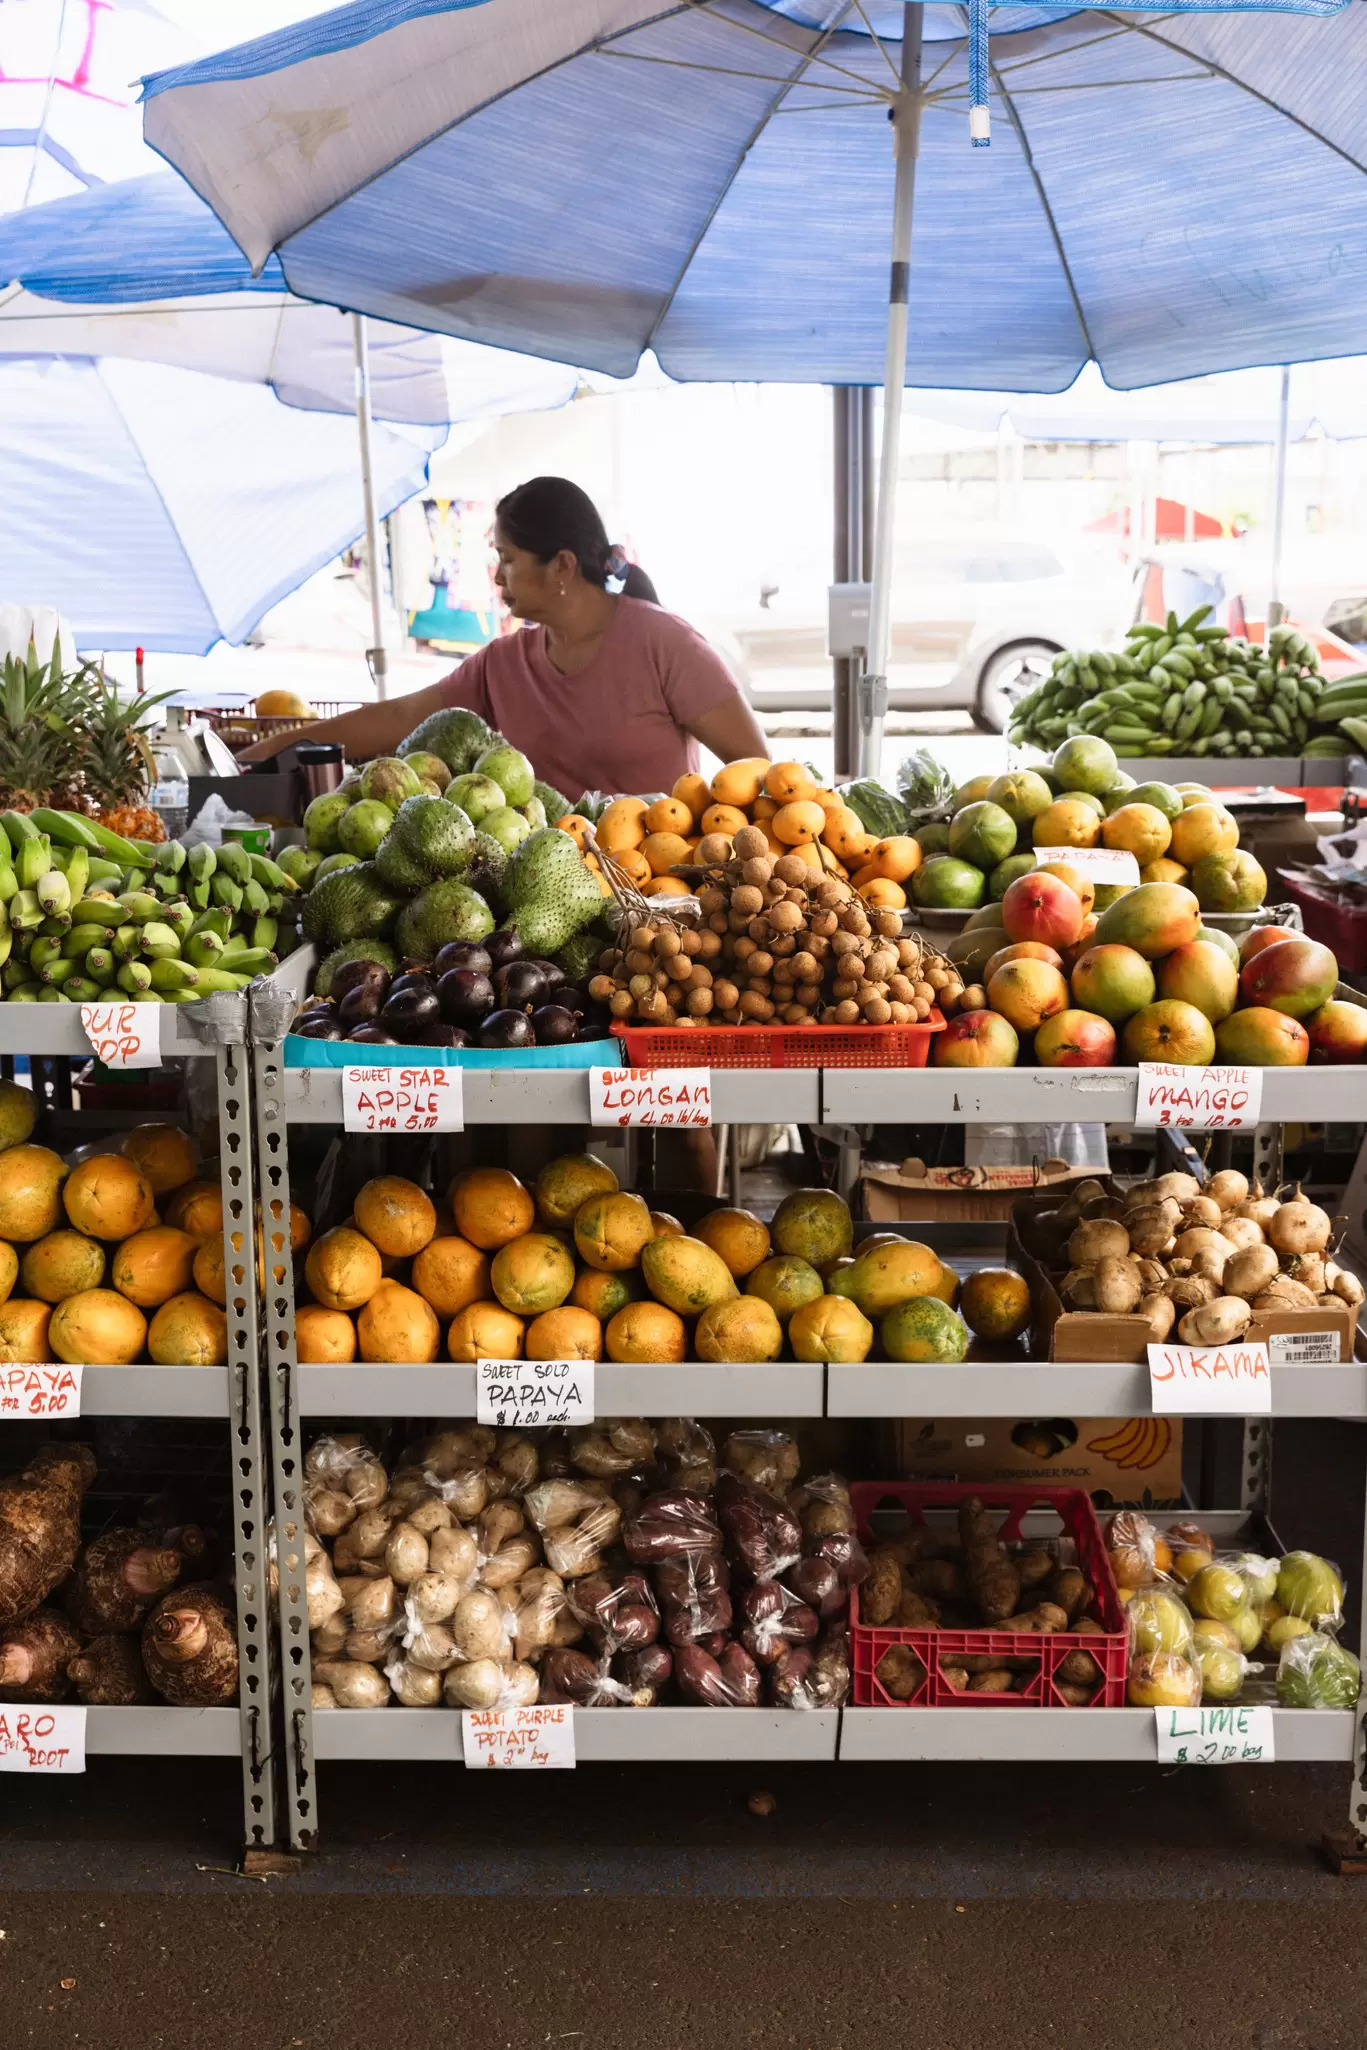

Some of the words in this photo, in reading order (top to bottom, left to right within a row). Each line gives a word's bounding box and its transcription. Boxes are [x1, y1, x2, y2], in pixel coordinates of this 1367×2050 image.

[91, 1036, 140, 1065] OP
[349, 1068, 392, 1083] SWEET
[399, 1068, 450, 1088] STAR
[1144, 1063, 1186, 1078] SWEET
[1201, 1067, 1252, 1084] APPLE
[357, 1090, 440, 1113] APPLE
[603, 1085, 710, 1108] LONGAN
[1148, 1085, 1249, 1110] MANGO
[405, 1114, 439, 1130] 5.00
[1156, 1110, 1171, 1127] 3
[482, 1364, 523, 1380] SWEET
[534, 1364, 570, 1378] SOLO
[1151, 1351, 1269, 1382] JIKAMA
[28, 1391, 68, 1414] 5.00
[487, 1382, 582, 1407] PAPAYA
[496, 1409, 507, 1426] $
[512, 1409, 540, 1426] 1.00
[995, 1467, 1060, 1479] CONSUMER
[1062, 1466, 1091, 1478] PACK
[514, 1707, 565, 1726] PURPLE
[1169, 1708, 1255, 1737] LIME
[474, 1728, 540, 1750] POTATO
[28, 1747, 70, 1769] ROOT
[1173, 1745, 1188, 1763] $
